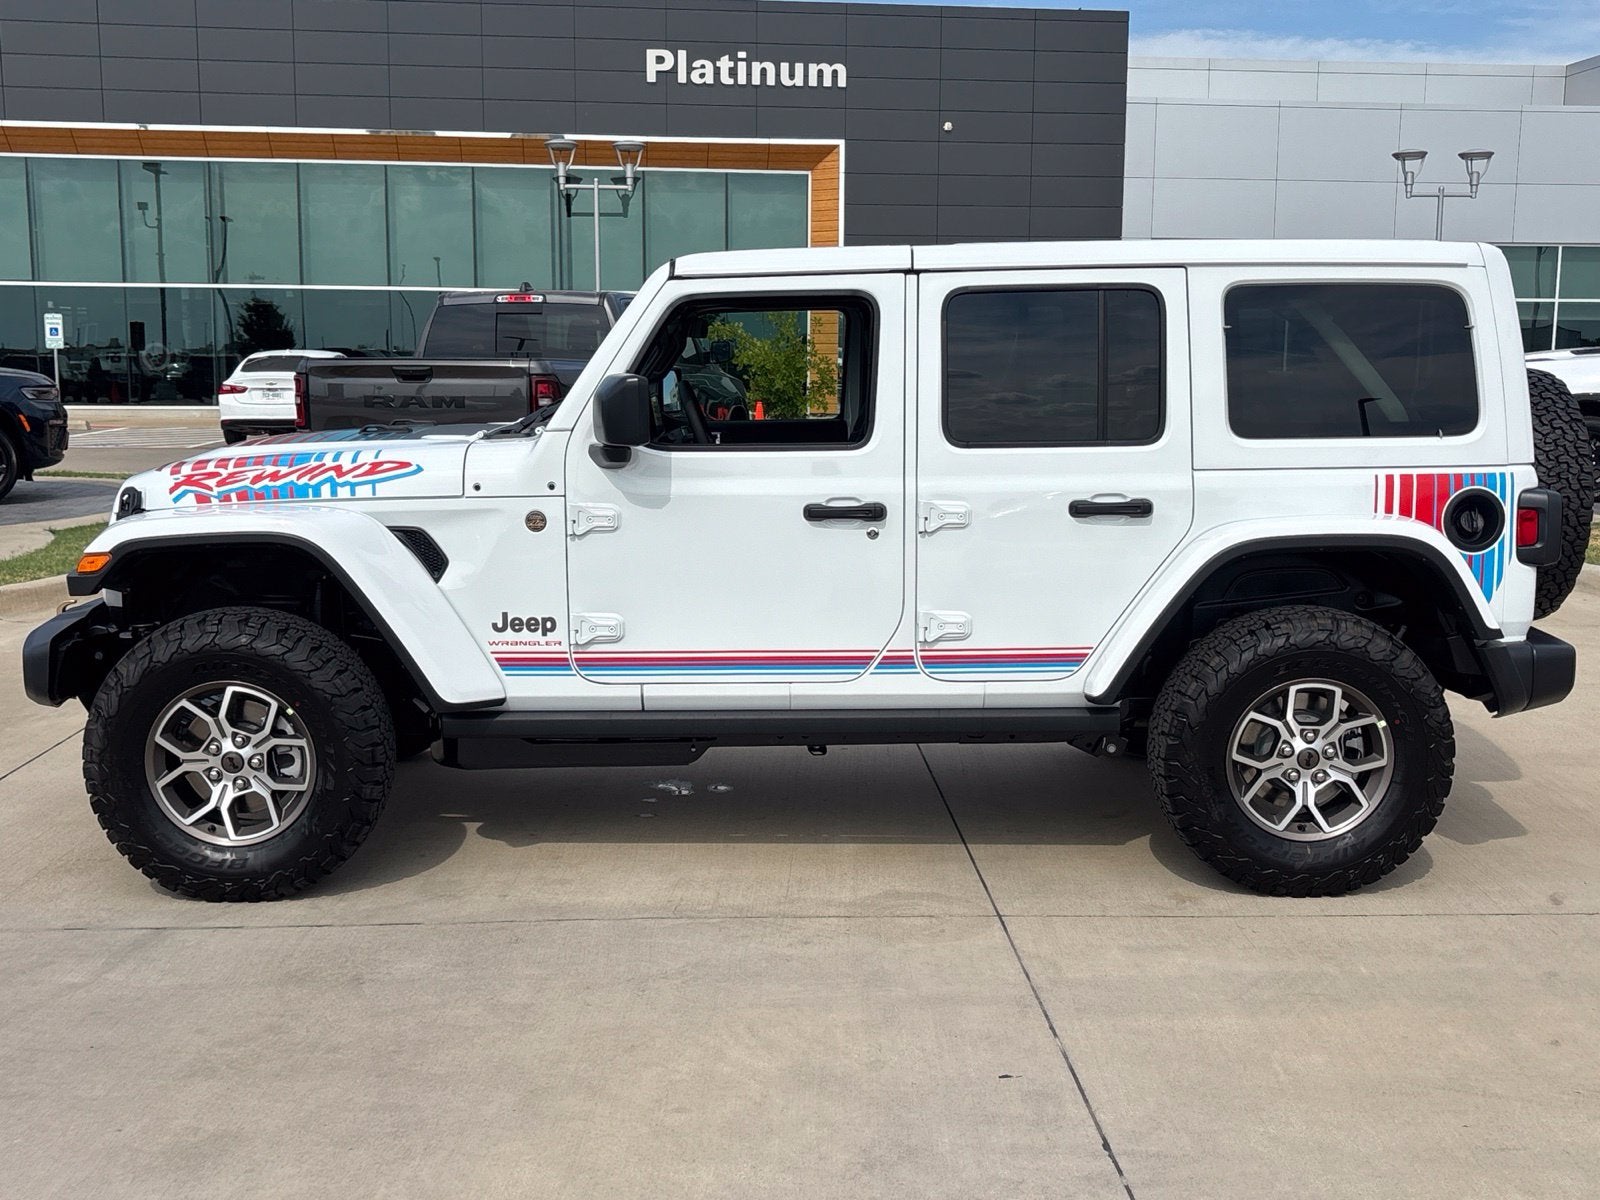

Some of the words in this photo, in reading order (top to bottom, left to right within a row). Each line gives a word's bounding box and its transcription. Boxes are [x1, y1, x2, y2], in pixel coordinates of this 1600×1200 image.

[646, 49, 847, 88] Platinum
[363, 395, 465, 408] RAM
[168, 460, 413, 497] REWIND
[491, 611, 557, 637] Jeep
